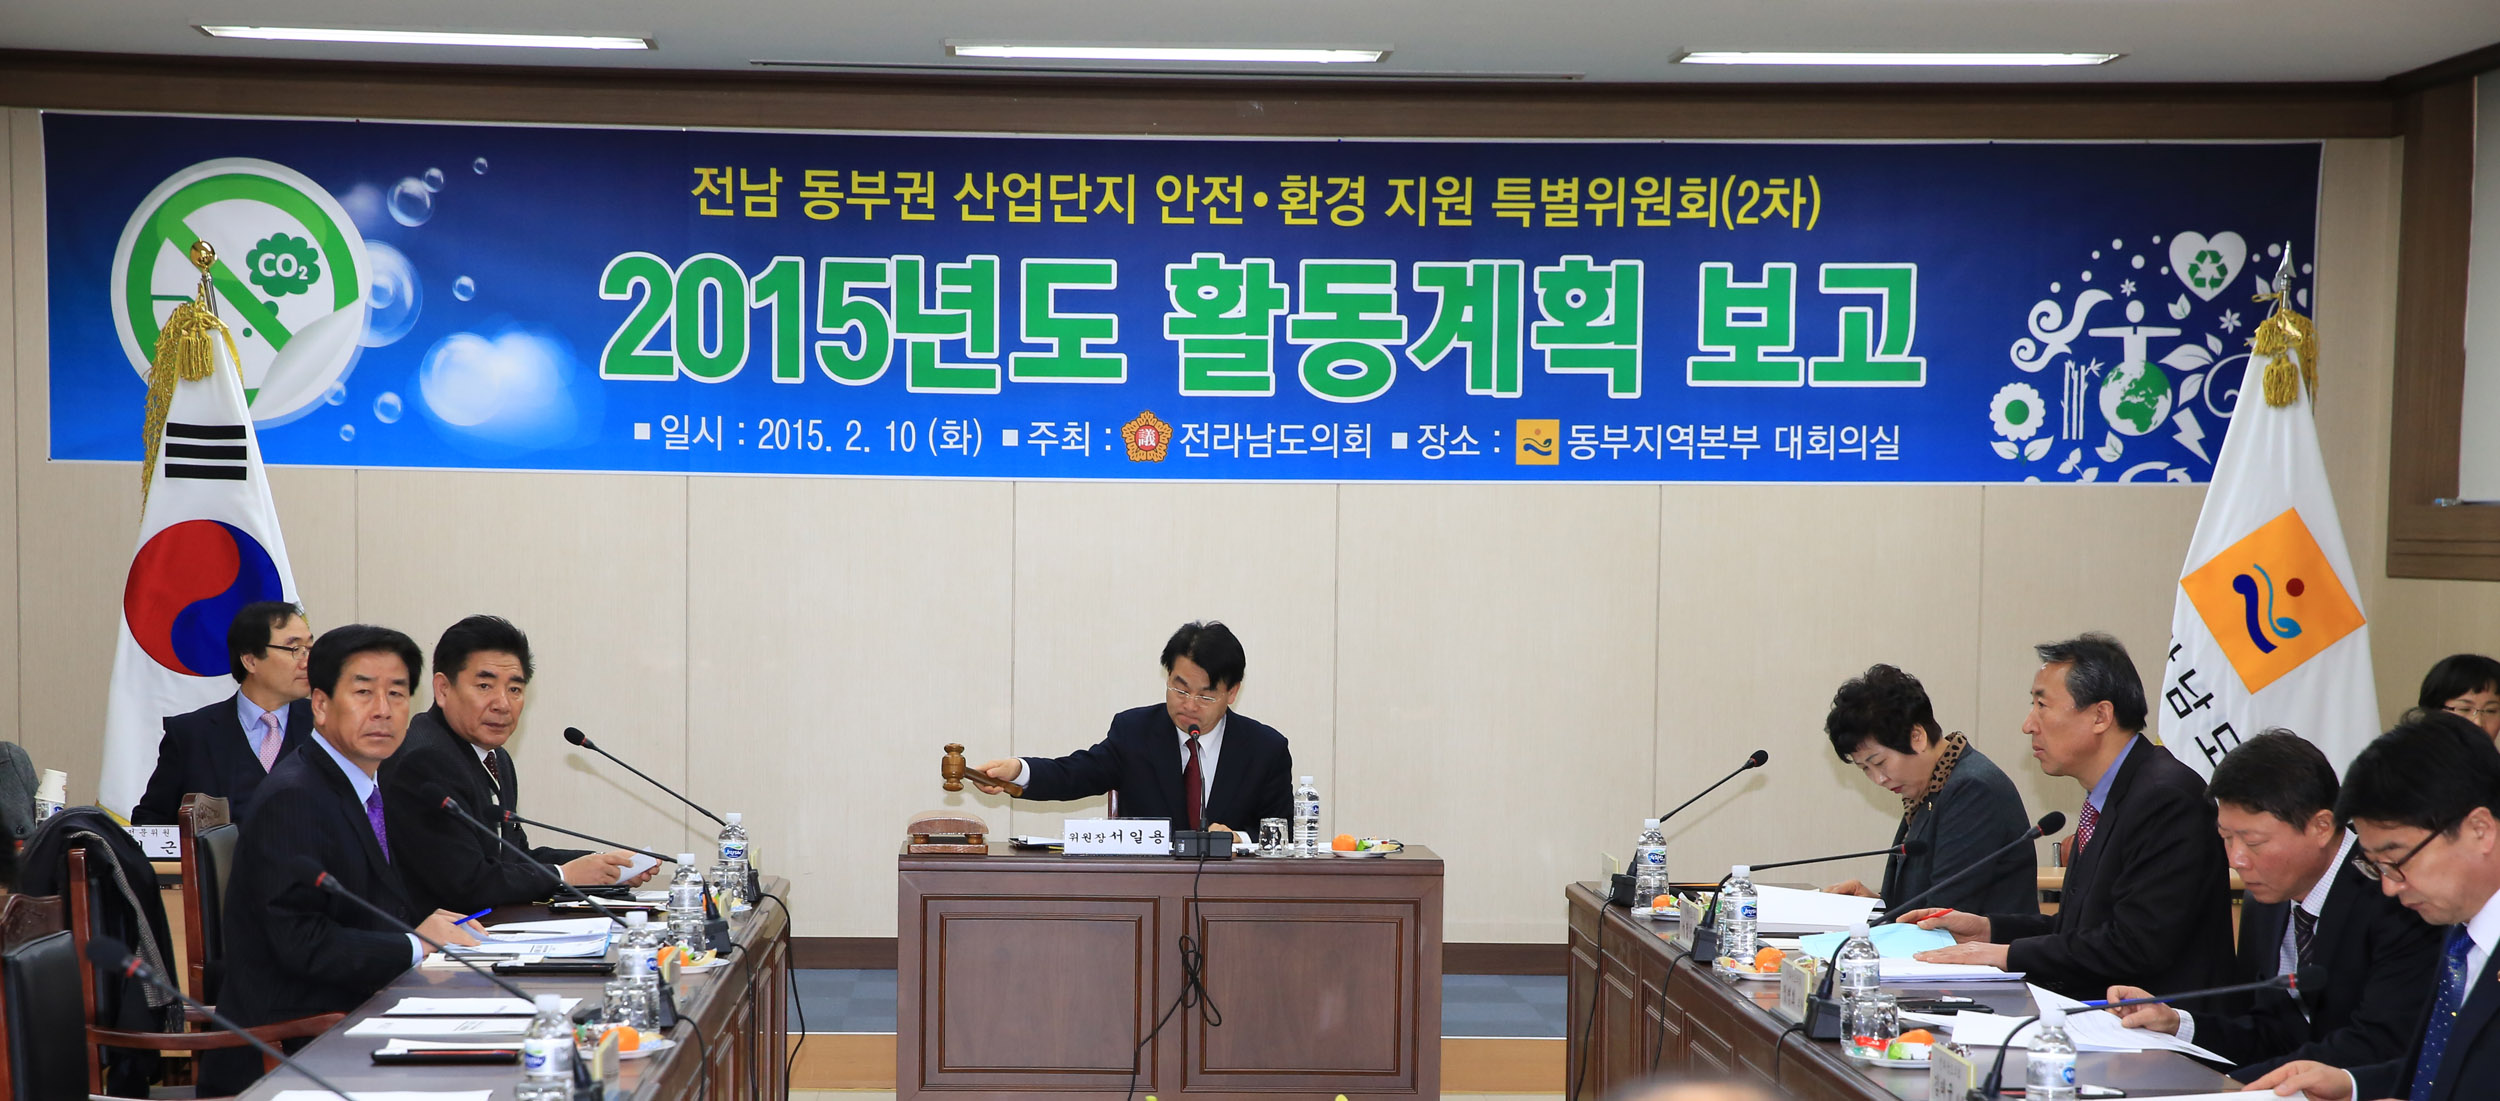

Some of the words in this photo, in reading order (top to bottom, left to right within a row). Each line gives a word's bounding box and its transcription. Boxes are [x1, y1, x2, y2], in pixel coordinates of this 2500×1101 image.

[692, 166, 783, 218] 전남
[799, 169, 935, 221] 동부권
[953, 172, 1135, 224] 산업단지
[1385, 176, 1473, 227] 지원
[1491, 174, 1821, 231] 특별위원회(2차)
[599, 251, 1128, 394] 2015년도
[1163, 253, 1644, 403] 활동계획
[1687, 262, 1927, 387] 보고
[661, 414, 723, 451] 일시
[758, 418, 832, 453] 2015.
[846, 419, 870, 453] 2.
[885, 420, 916, 453] 10
[928, 417, 982, 457] (화)
[1027, 421, 1090, 457] 주최
[1179, 422, 1371, 459] 전라남도의회
[1417, 423, 1481, 459] 장소
[1567, 424, 1761, 461] 동부지역본부
[1775, 425, 1899, 461] 대회의실
[1069, 832, 1106, 844] 위원장
